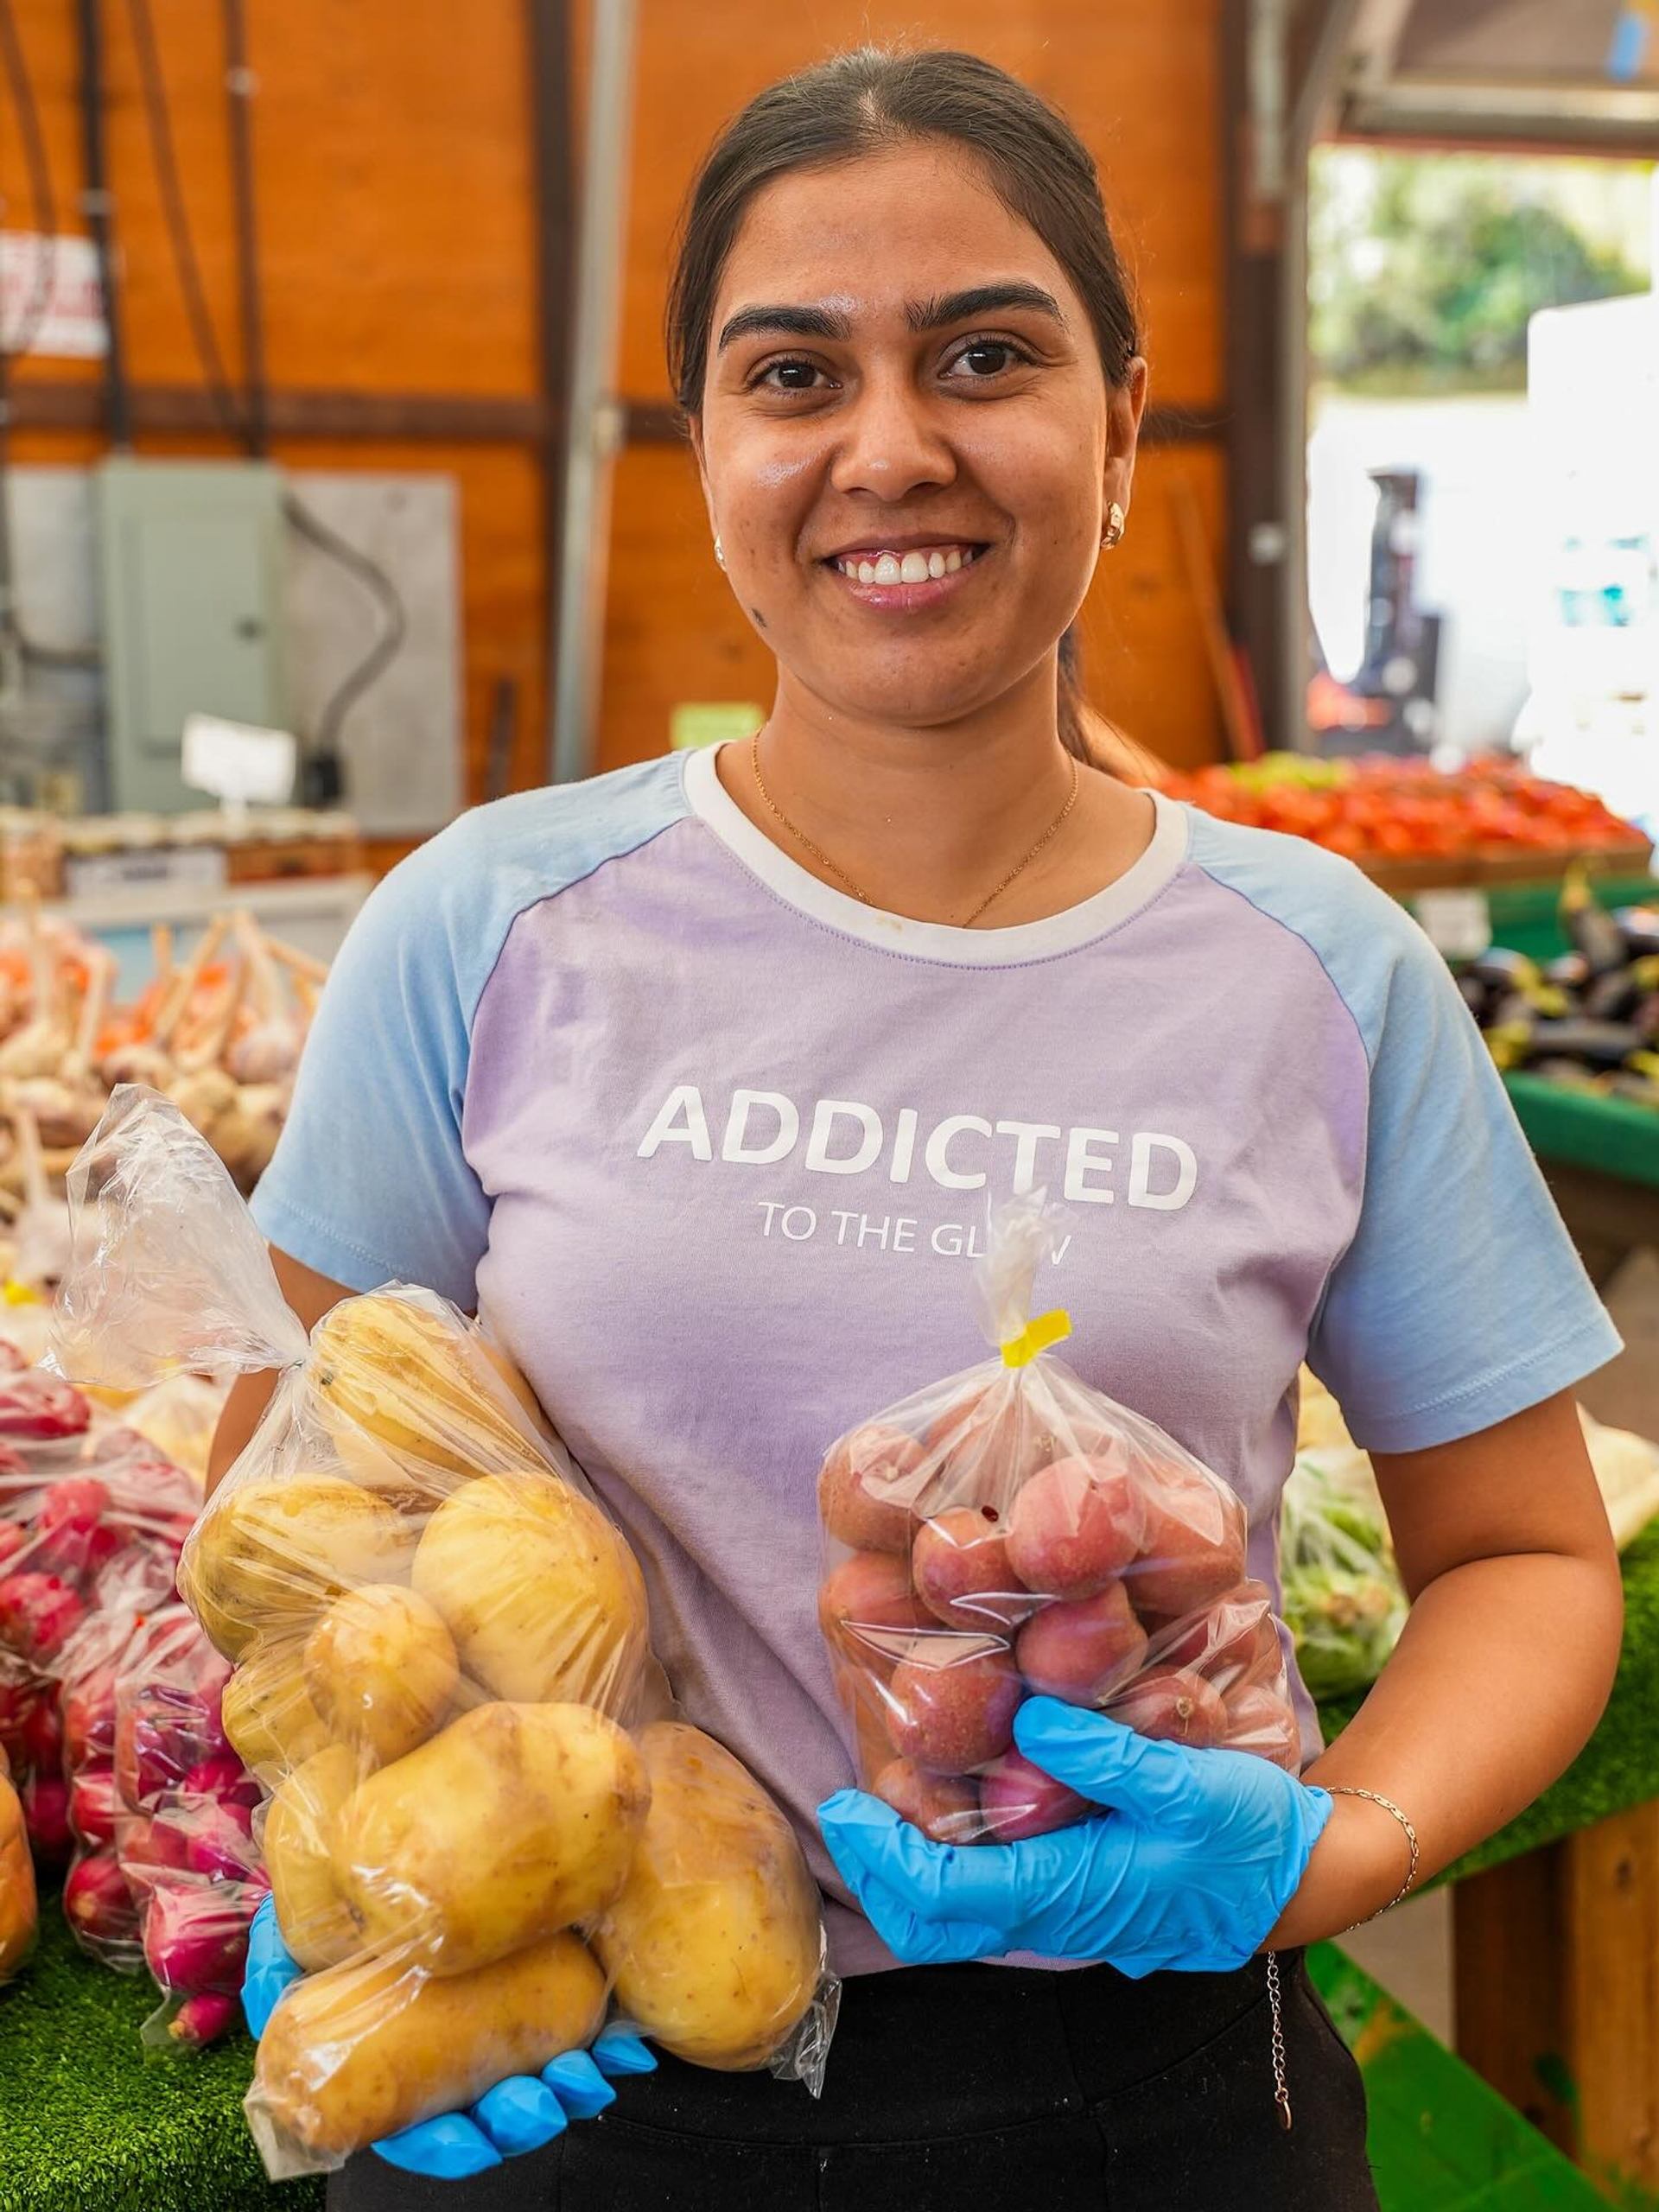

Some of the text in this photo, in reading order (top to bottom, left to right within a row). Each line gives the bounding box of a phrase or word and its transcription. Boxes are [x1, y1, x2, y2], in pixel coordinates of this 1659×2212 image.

[637, 1085, 1198, 1211] ADDICTED
[758, 1201, 1072, 1266] TO THE GL
